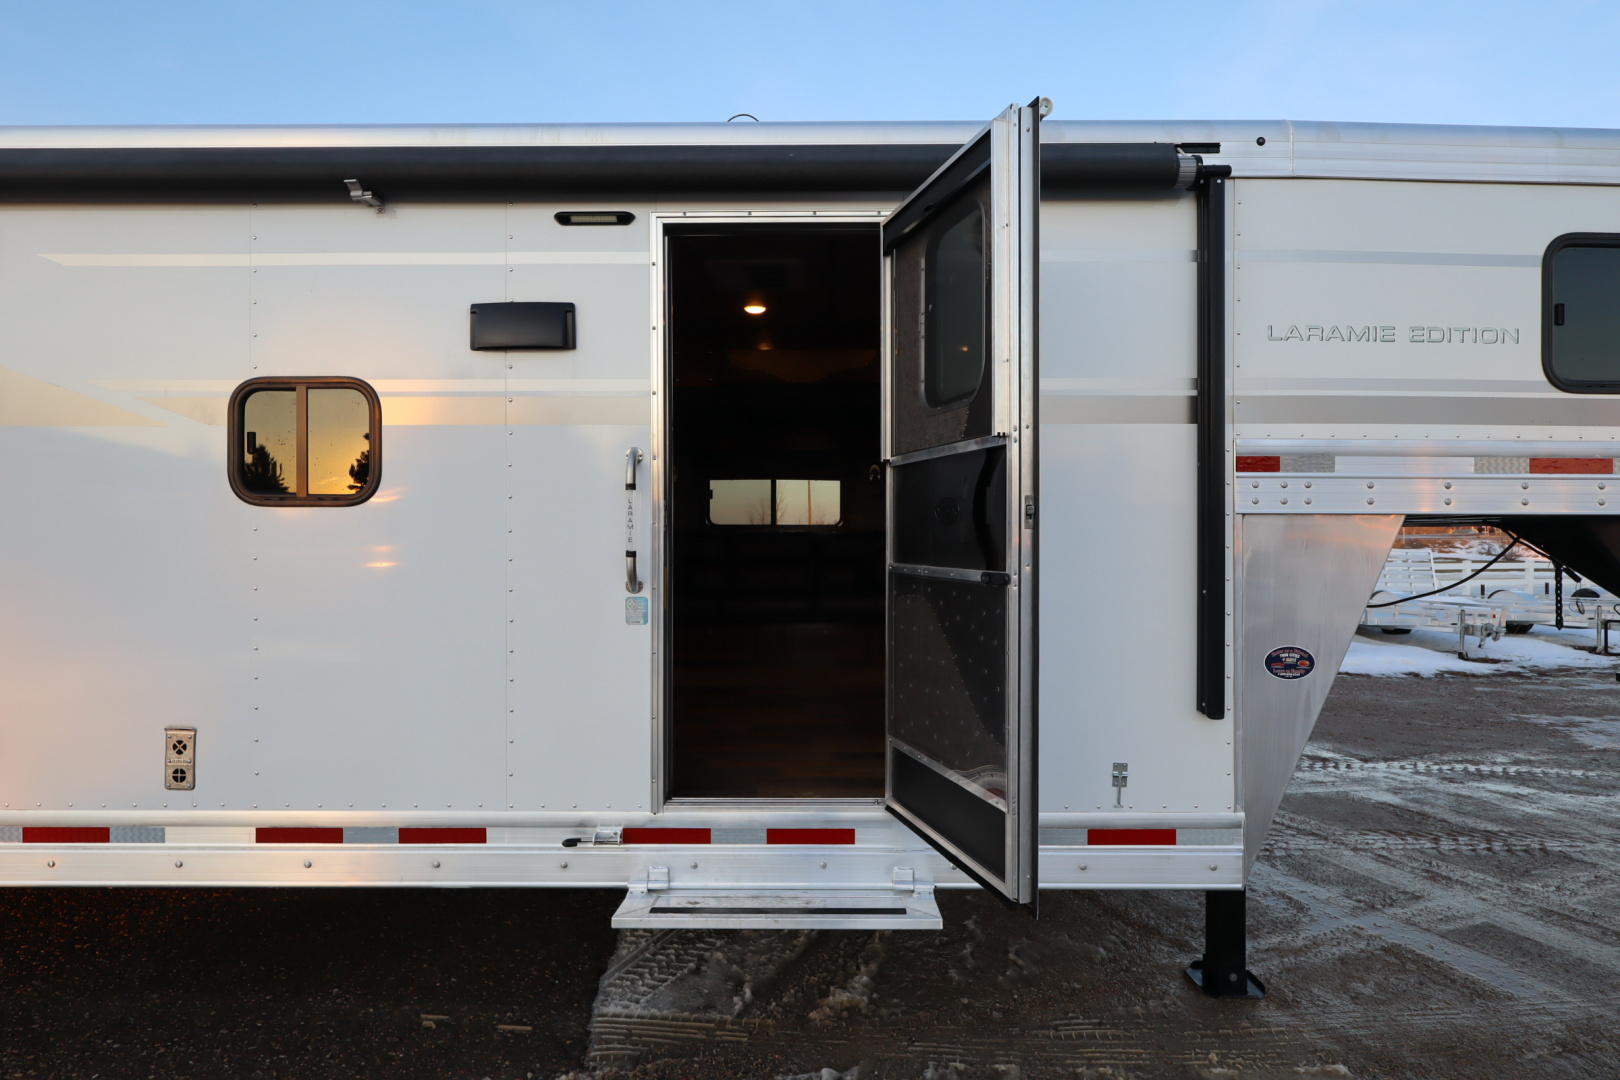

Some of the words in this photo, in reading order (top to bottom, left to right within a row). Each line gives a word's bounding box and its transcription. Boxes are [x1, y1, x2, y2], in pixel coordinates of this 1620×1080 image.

[1266, 324, 1396, 342] LARAMIE
[1408, 326, 1520, 345] EDITION
[626, 498, 634, 543] LARAMIE
